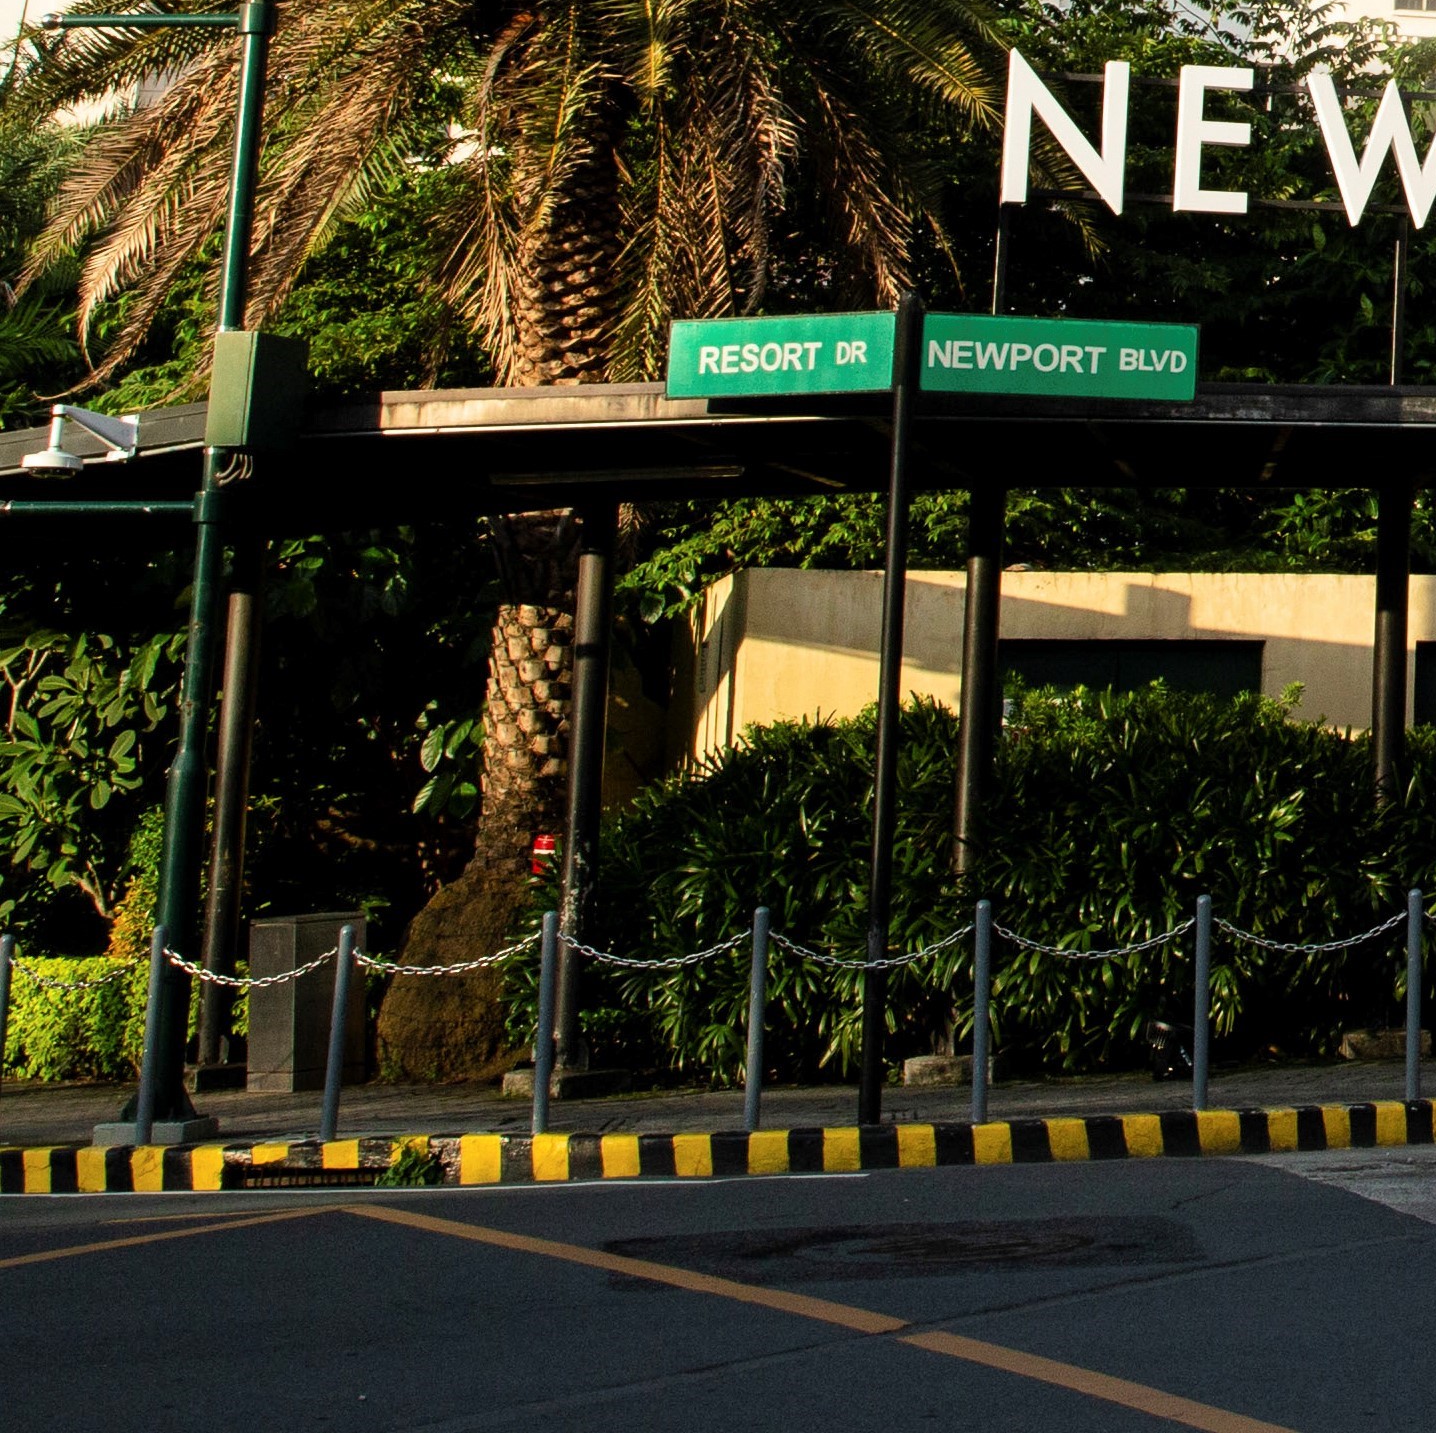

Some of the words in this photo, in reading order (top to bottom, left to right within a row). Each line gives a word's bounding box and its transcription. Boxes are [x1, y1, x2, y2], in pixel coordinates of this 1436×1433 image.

[698, 342, 822, 374] RESORT
[836, 341, 867, 365] DR
[927, 340, 1106, 374] NEWPORT
[1119, 348, 1187, 373] BLVD
